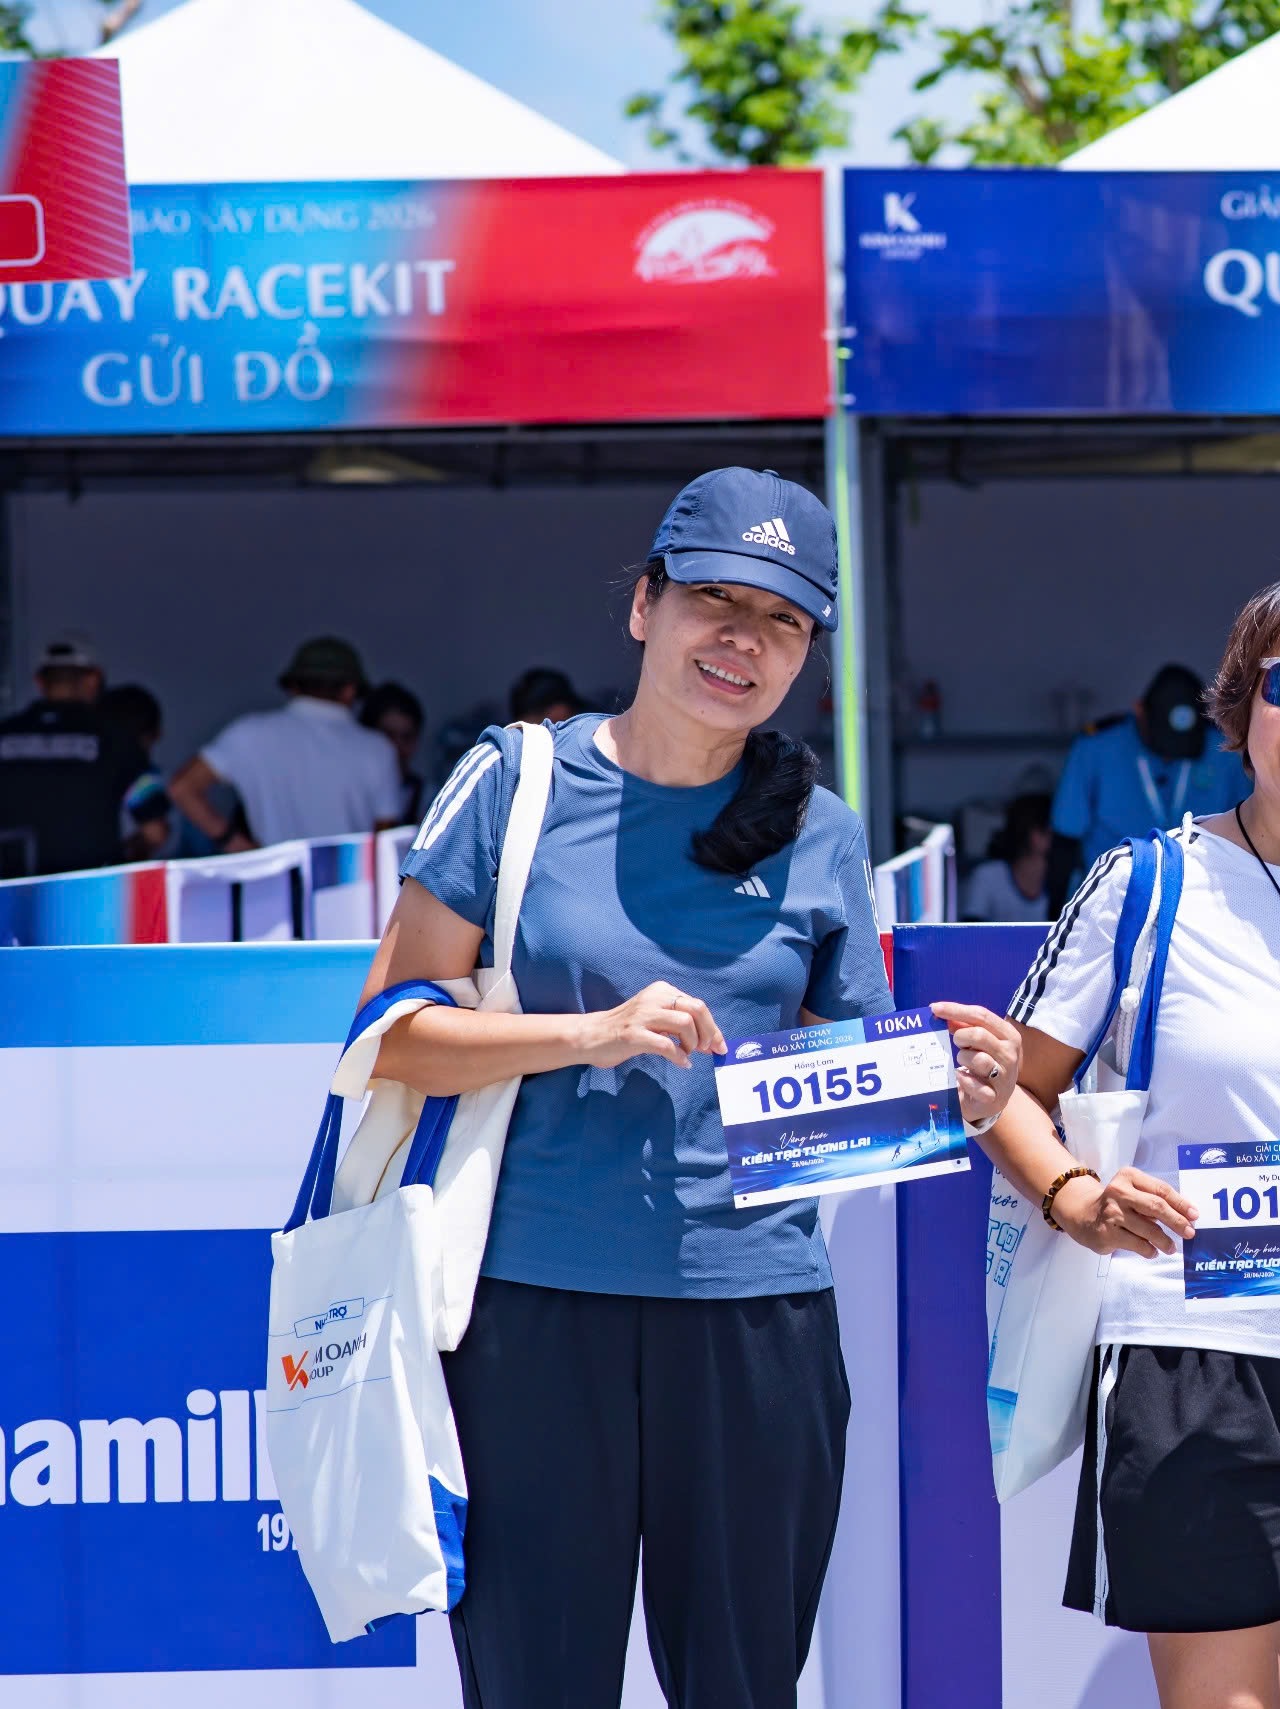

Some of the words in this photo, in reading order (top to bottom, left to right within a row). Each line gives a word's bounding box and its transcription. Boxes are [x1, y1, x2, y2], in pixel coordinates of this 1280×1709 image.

[172, 259, 456, 322] RACEKIT
[82, 333, 204, 407] GỬI
[234, 321, 333, 402] ĐỒ
[742, 531, 796, 556] adidas
[875, 1014, 922, 1034] 10KM
[834, 1035, 853, 1044] 2026
[752, 1061, 882, 1113] 10155
[741, 1151, 773, 1166] KIẾN
[774, 1148, 802, 1161] TẠO
[850, 1136, 871, 1148] LAI
[1195, 1258, 1226, 1271] KIẾN
[1228, 1259, 1254, 1271] TẠO
[329, 1305, 347, 1319] TRỢ
[310, 1365, 333, 1380] OUP
[0, 1389, 280, 1507] amil
[257, 1513, 299, 1551] 19
